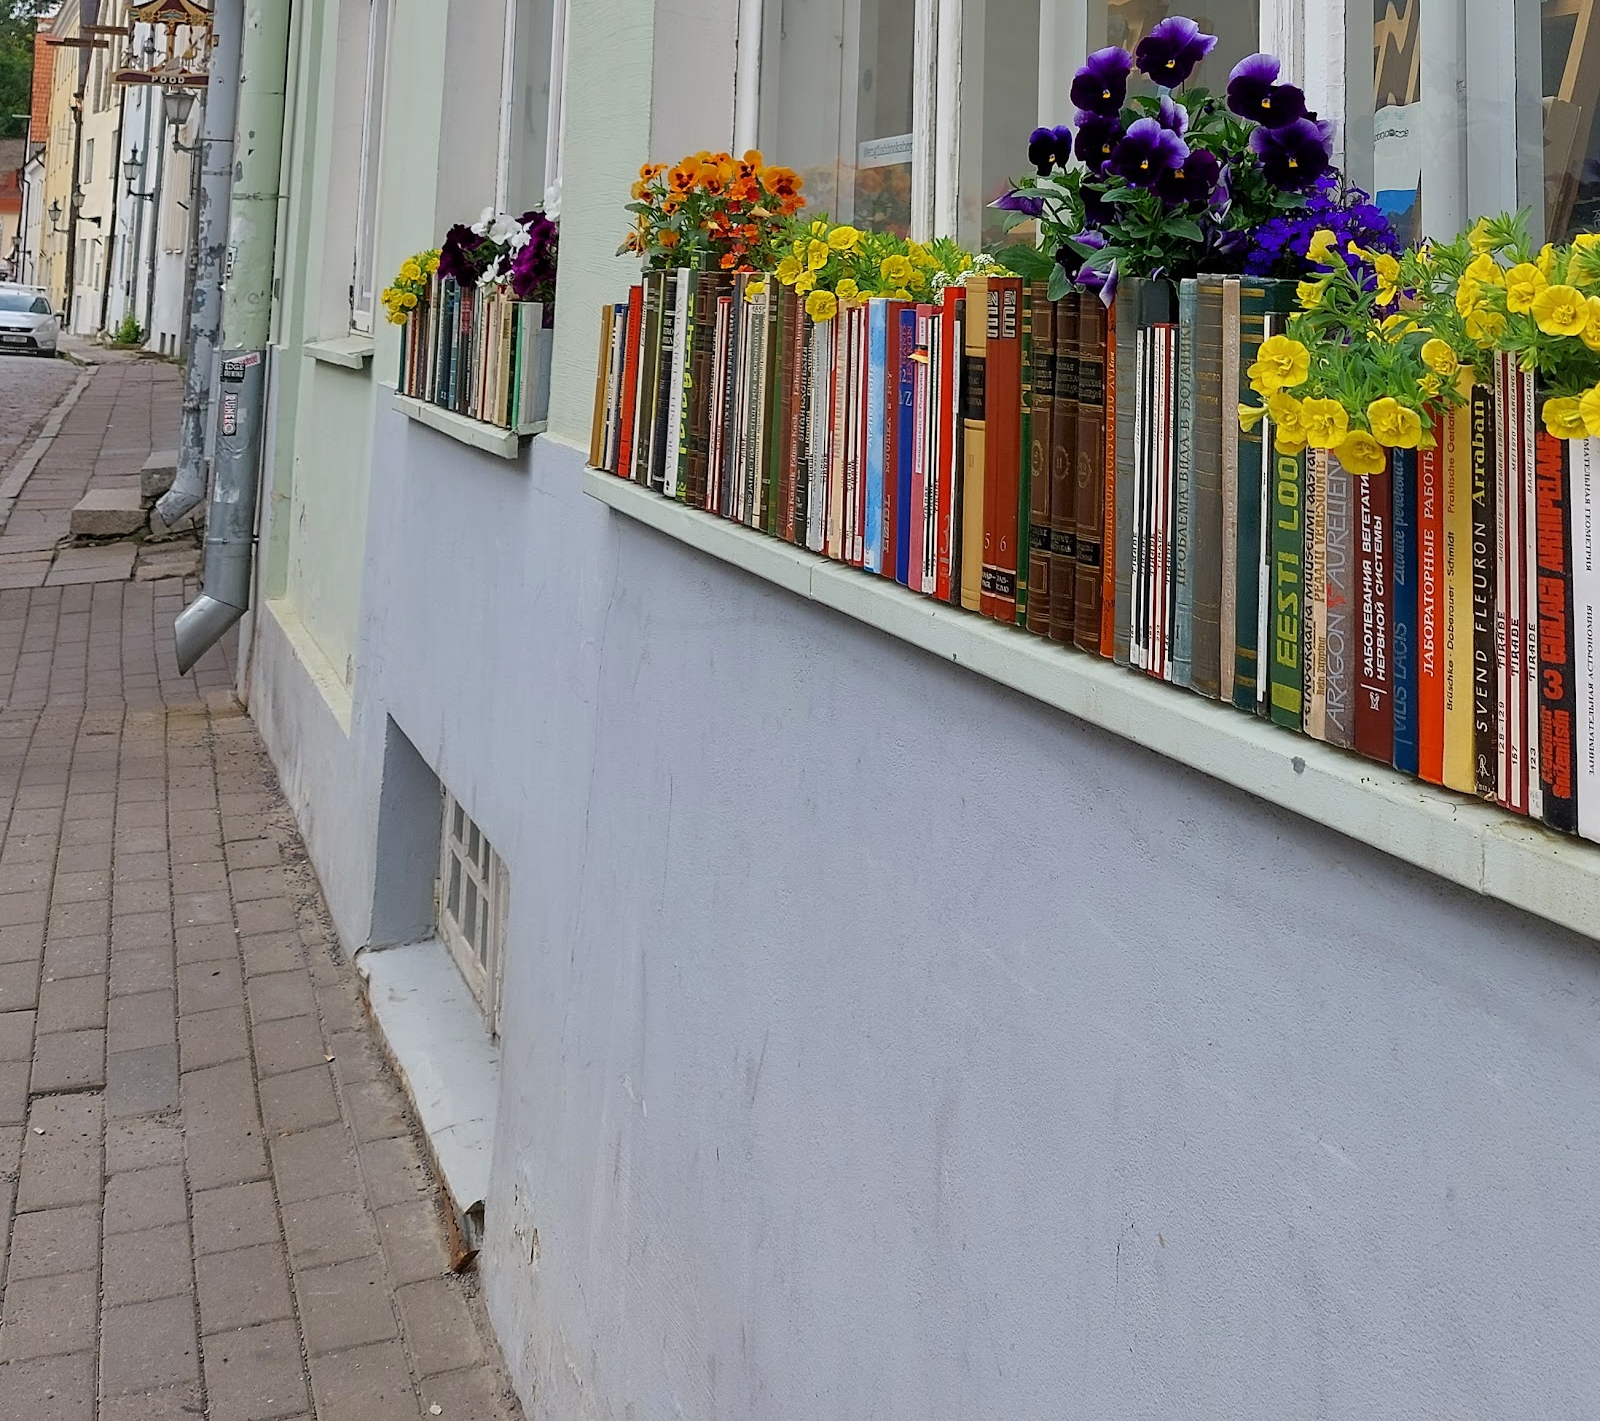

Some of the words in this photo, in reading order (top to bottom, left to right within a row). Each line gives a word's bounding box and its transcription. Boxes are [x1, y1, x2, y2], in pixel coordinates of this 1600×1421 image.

[151, 74, 185, 84] POOD
[1179, 319, 1191, 411] БОТАНИКЕ
[1179, 419, 1190, 430] В
[1393, 448, 1404, 458] 2
[1471, 400, 1486, 507] Arraban
[1178, 435, 1191, 482] ВИДА
[1447, 457, 1456, 513] Praktische
[1277, 454, 1299, 530] LOO
[1536, 432, 1563, 571] ARHIPELAAG
[984, 532, 991, 549] 5
[999, 535, 1007, 552] 6
[1176, 490, 1189, 587] ПРОБЛЕМА
[1326, 460, 1349, 589] AURELIEN
[1373, 516, 1384, 596] СИСТЕМЫ
[1446, 531, 1455, 576] Schmidt
[1584, 509, 1592, 571] ГЕОМЕТРИЯ
[1314, 551, 1325, 603] PEAAJU
[1423, 529, 1435, 677] ЛАБОРАТОРНЫЕ
[1473, 522, 1488, 633] FLEURON
[1276, 551, 1299, 669] EESTI
[1362, 561, 1374, 678] ЗАБОЛЕВАНИЯ
[1373, 602, 1386, 681] НЕРВНОЙ
[1446, 585, 1455, 650] Doberauer
[1497, 611, 1506, 670] TIRADE
[1538, 577, 1567, 664] GULAGI
[1326, 613, 1347, 732] ARAGON
[1393, 622, 1407, 679] LACIS
[1510, 618, 1520, 677] TIRADE
[1528, 623, 1537, 682] TIRADE
[1585, 605, 1594, 680] АСТРОНОМИЯ
[1316, 676, 1325, 696] Rein
[1393, 686, 1407, 734] VILIS
[1446, 660, 1455, 711] Brüschke
[1475, 650, 1488, 733] SVEND
[1544, 669, 1563, 700] 3
[1587, 682, 1595, 775] ЗАНИМАТЕЛЬНАЯ
